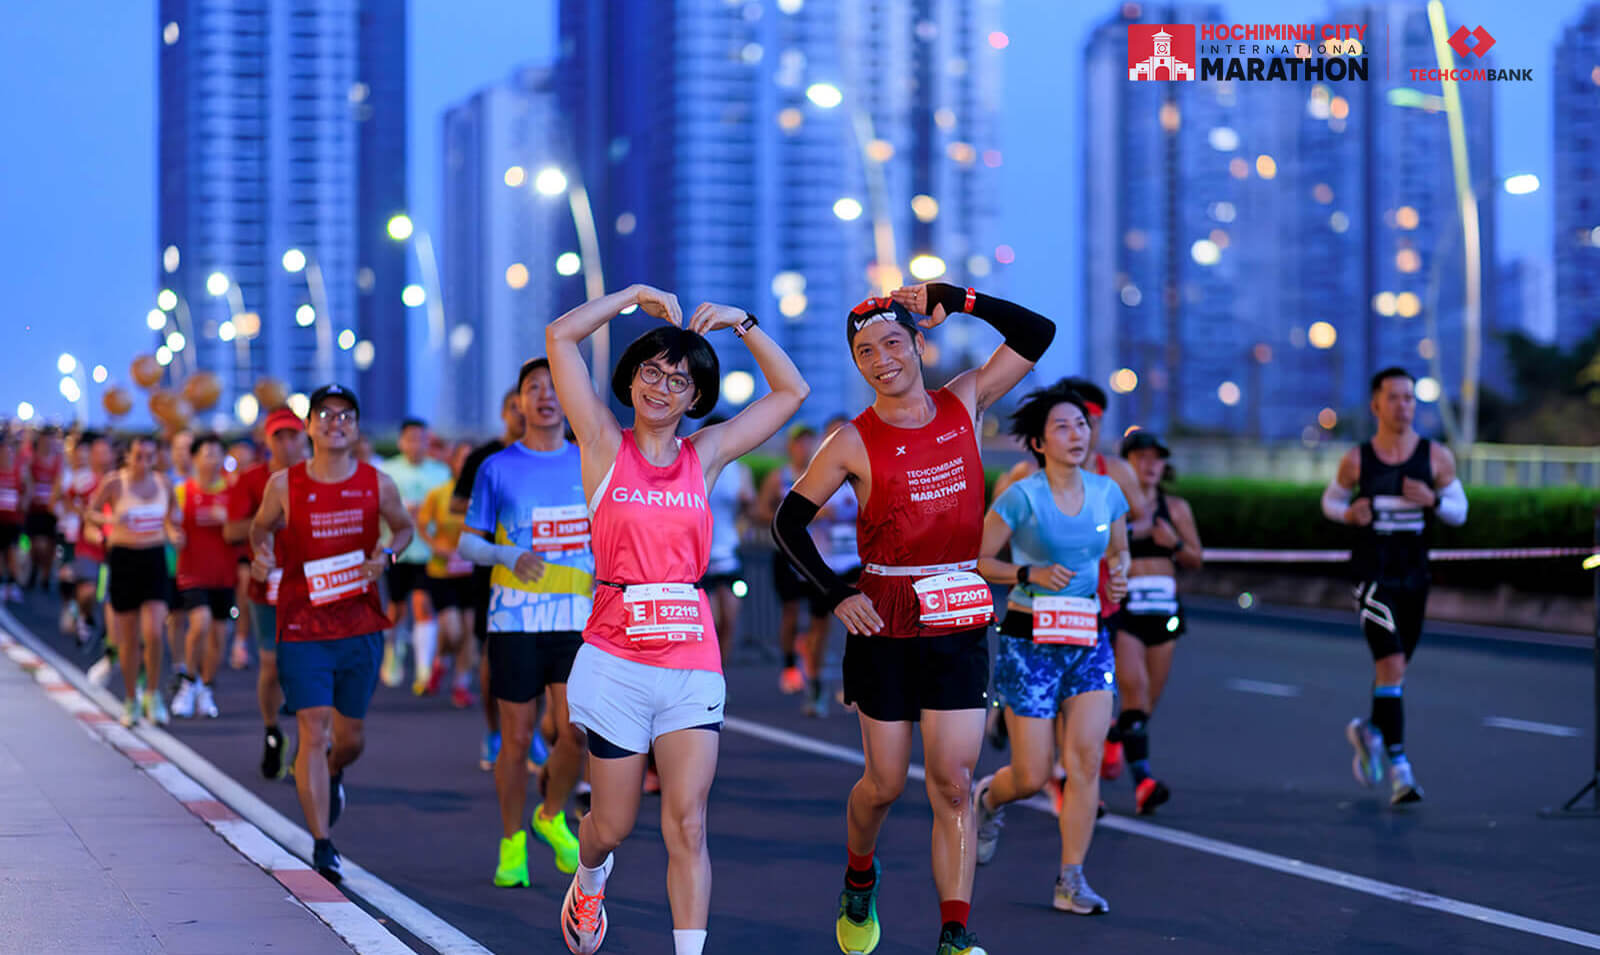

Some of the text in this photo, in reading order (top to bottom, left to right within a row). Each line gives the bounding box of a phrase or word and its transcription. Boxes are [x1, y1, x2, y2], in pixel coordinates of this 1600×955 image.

[612, 487, 706, 512] GARMIN
[911, 480, 966, 502] MARATHON
[538, 523, 551, 536] C
[312, 577, 325, 591] D
[926, 593, 940, 610] C
[948, 589, 988, 604] 372017
[633, 604, 698, 621] E 372115
[1040, 613, 1053, 627] D
